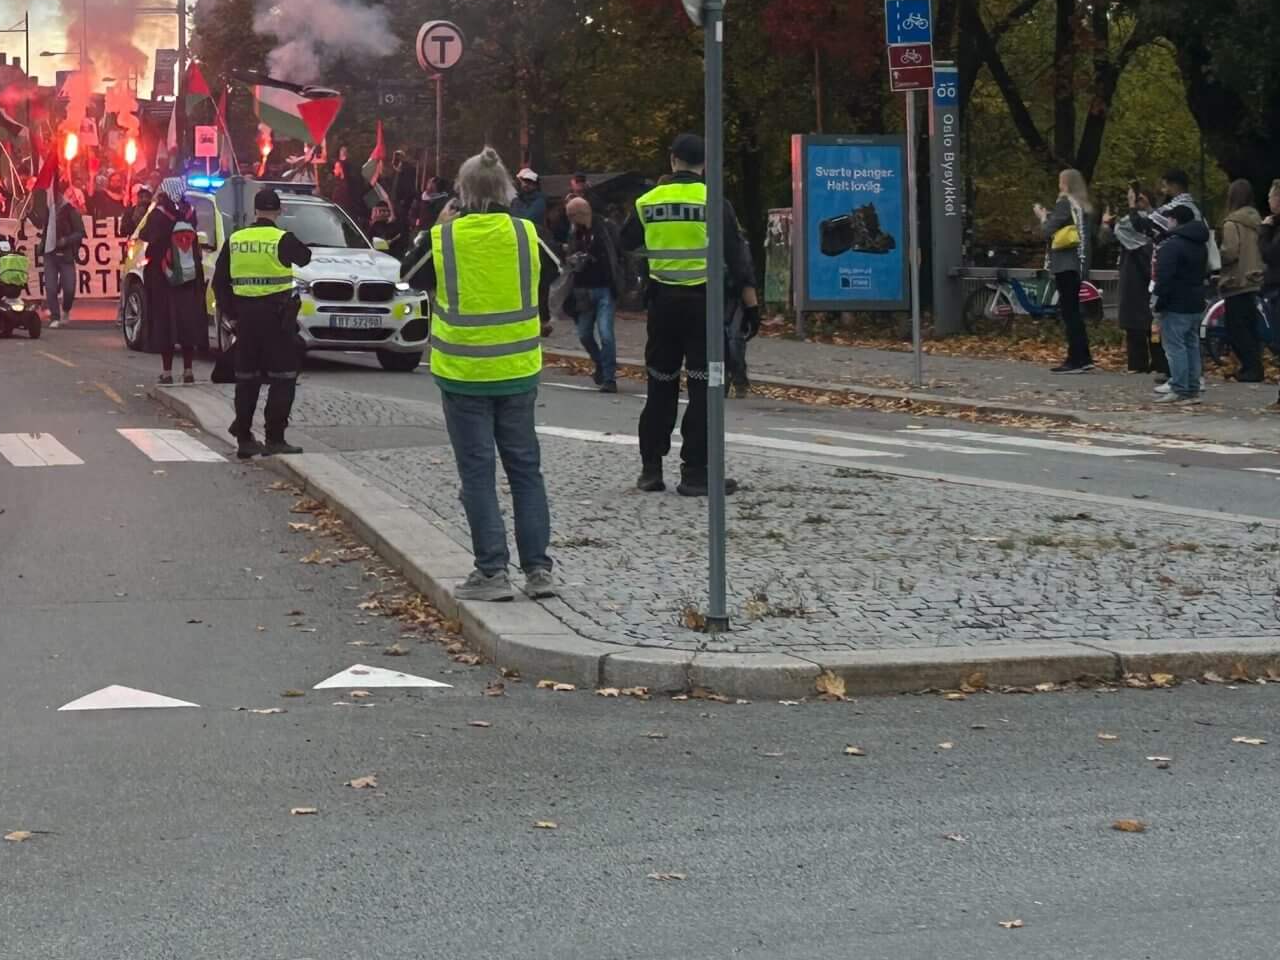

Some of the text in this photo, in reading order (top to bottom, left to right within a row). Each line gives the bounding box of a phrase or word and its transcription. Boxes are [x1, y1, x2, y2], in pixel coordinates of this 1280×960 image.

[431, 36, 455, 65] T
[943, 114, 954, 147] Oslo
[643, 204, 705, 221] POLITI
[231, 241, 277, 254] POLITI
